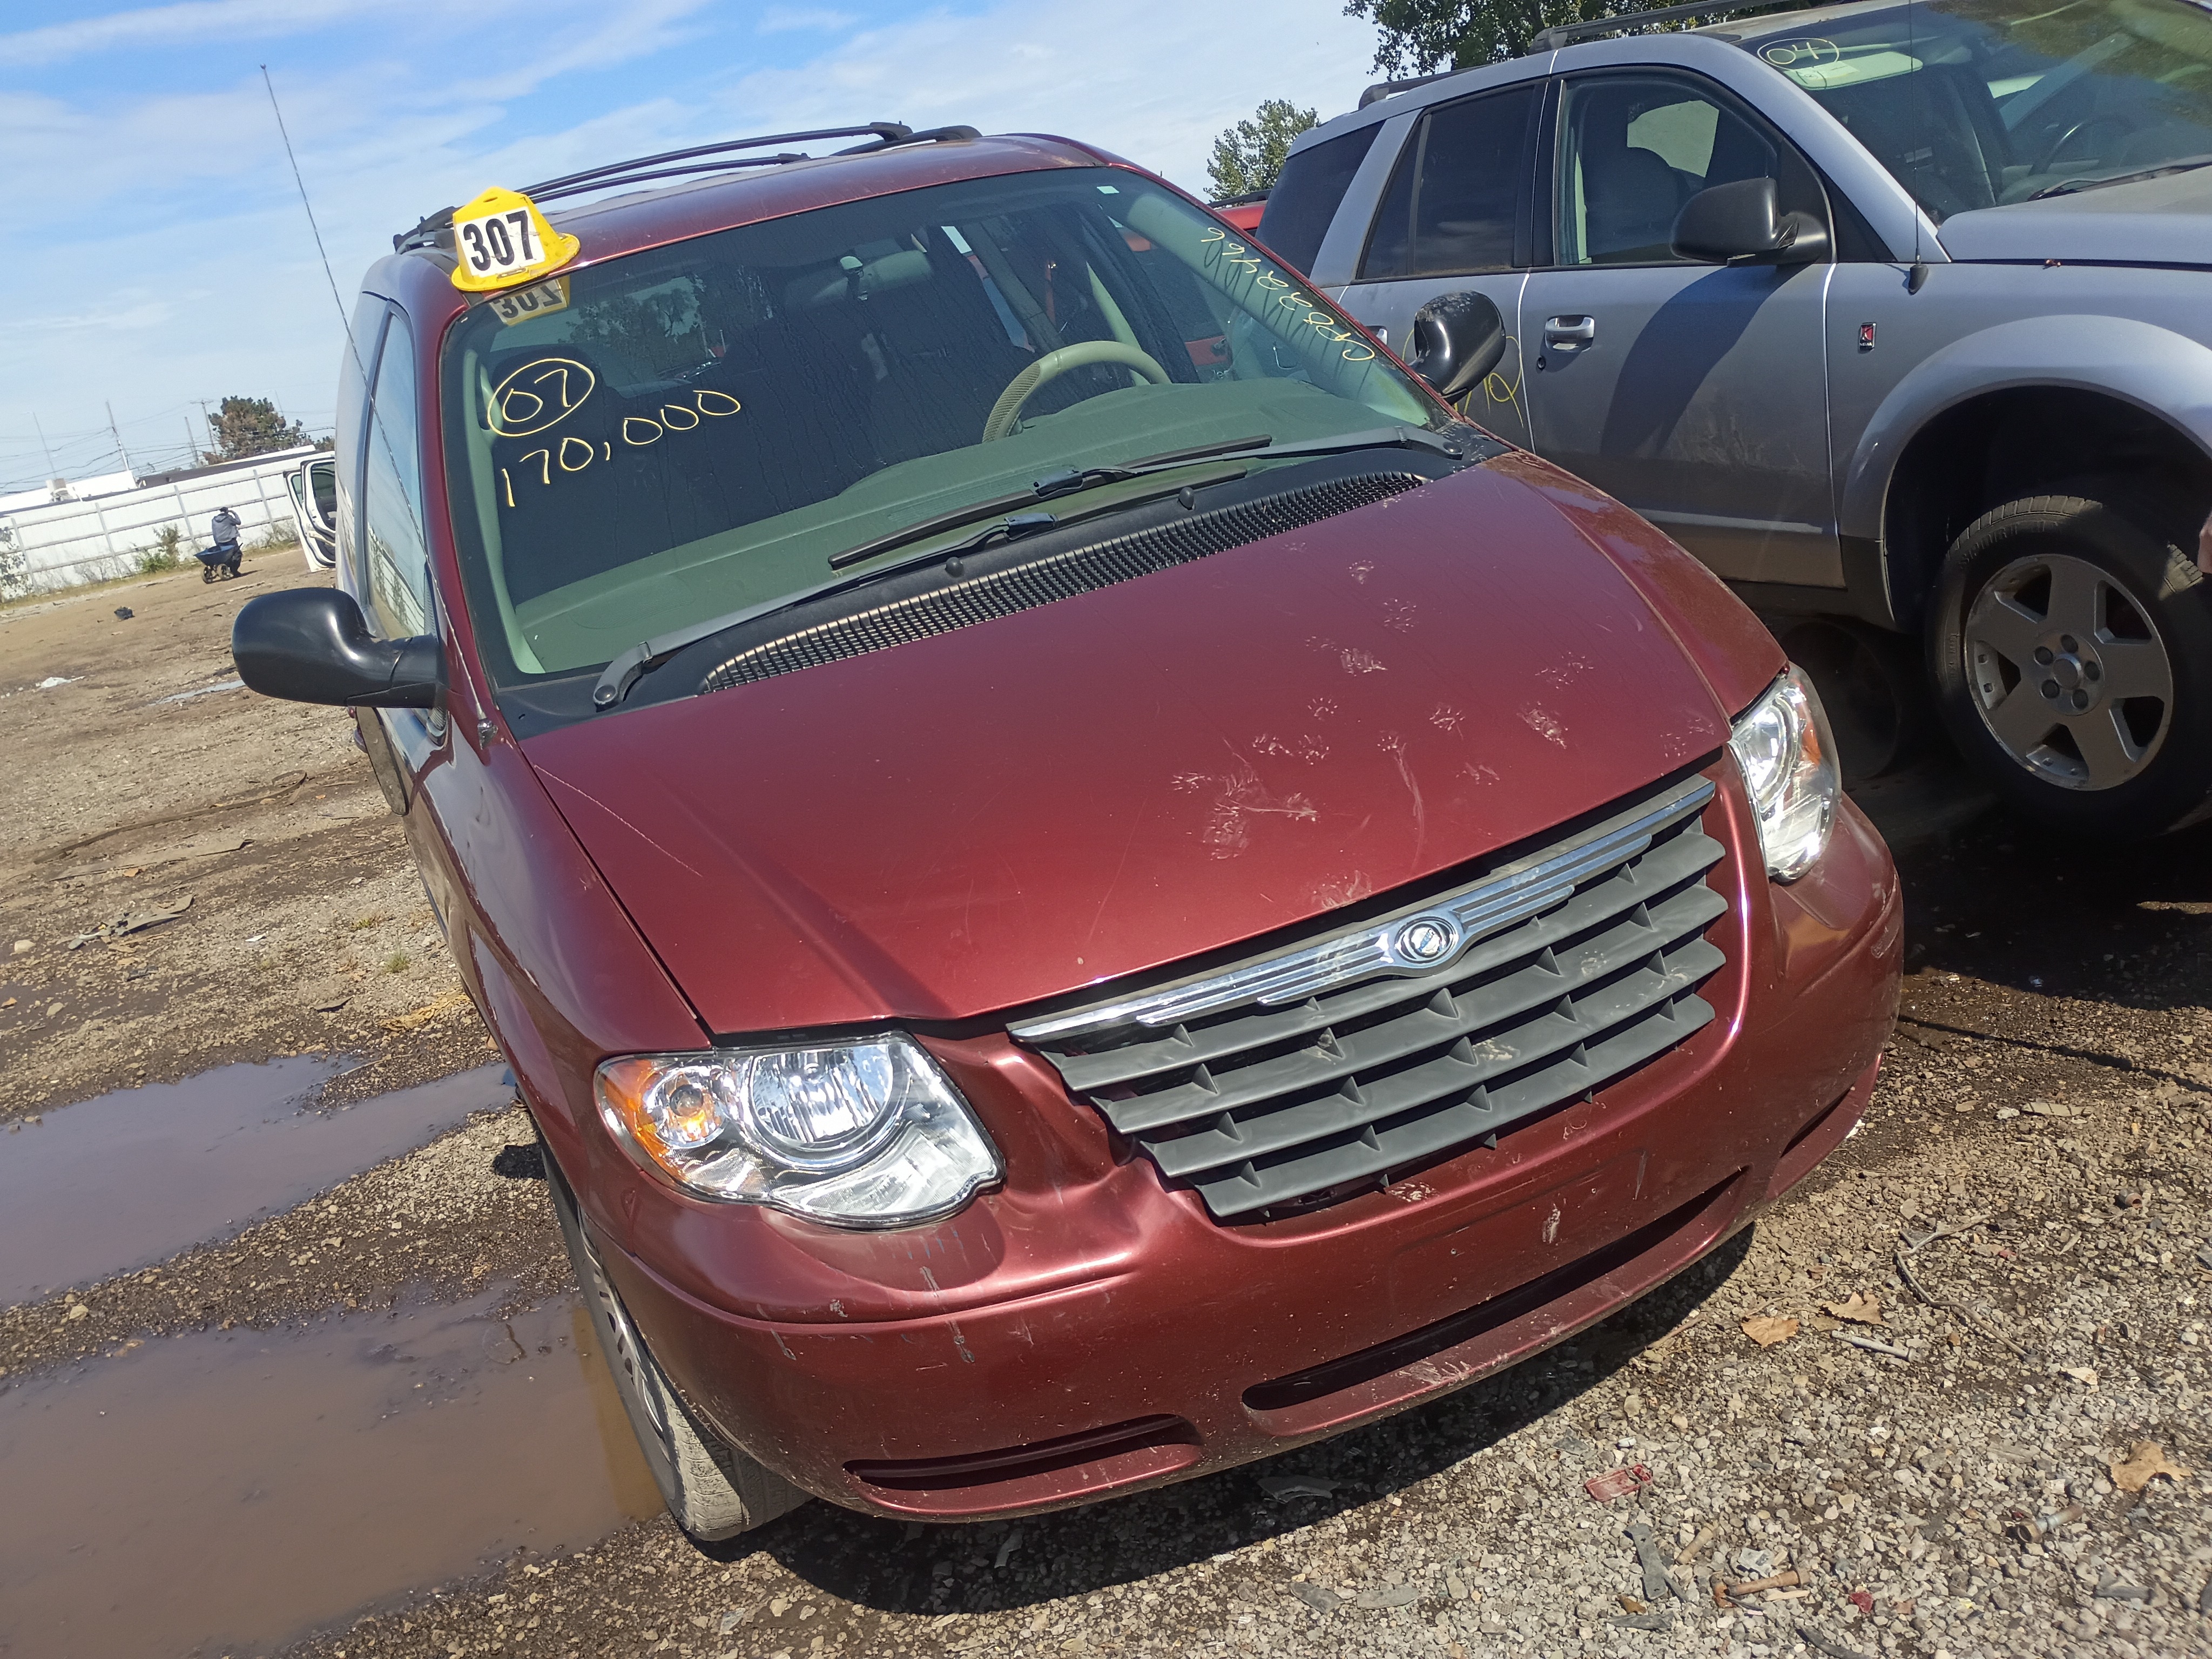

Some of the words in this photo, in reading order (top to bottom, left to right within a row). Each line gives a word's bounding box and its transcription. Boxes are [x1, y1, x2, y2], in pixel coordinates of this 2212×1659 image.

[1766, 42, 1819, 65] 04
[463, 210, 534, 271] 307
[502, 369, 571, 422] 07
[502, 389, 741, 507] 170,000
